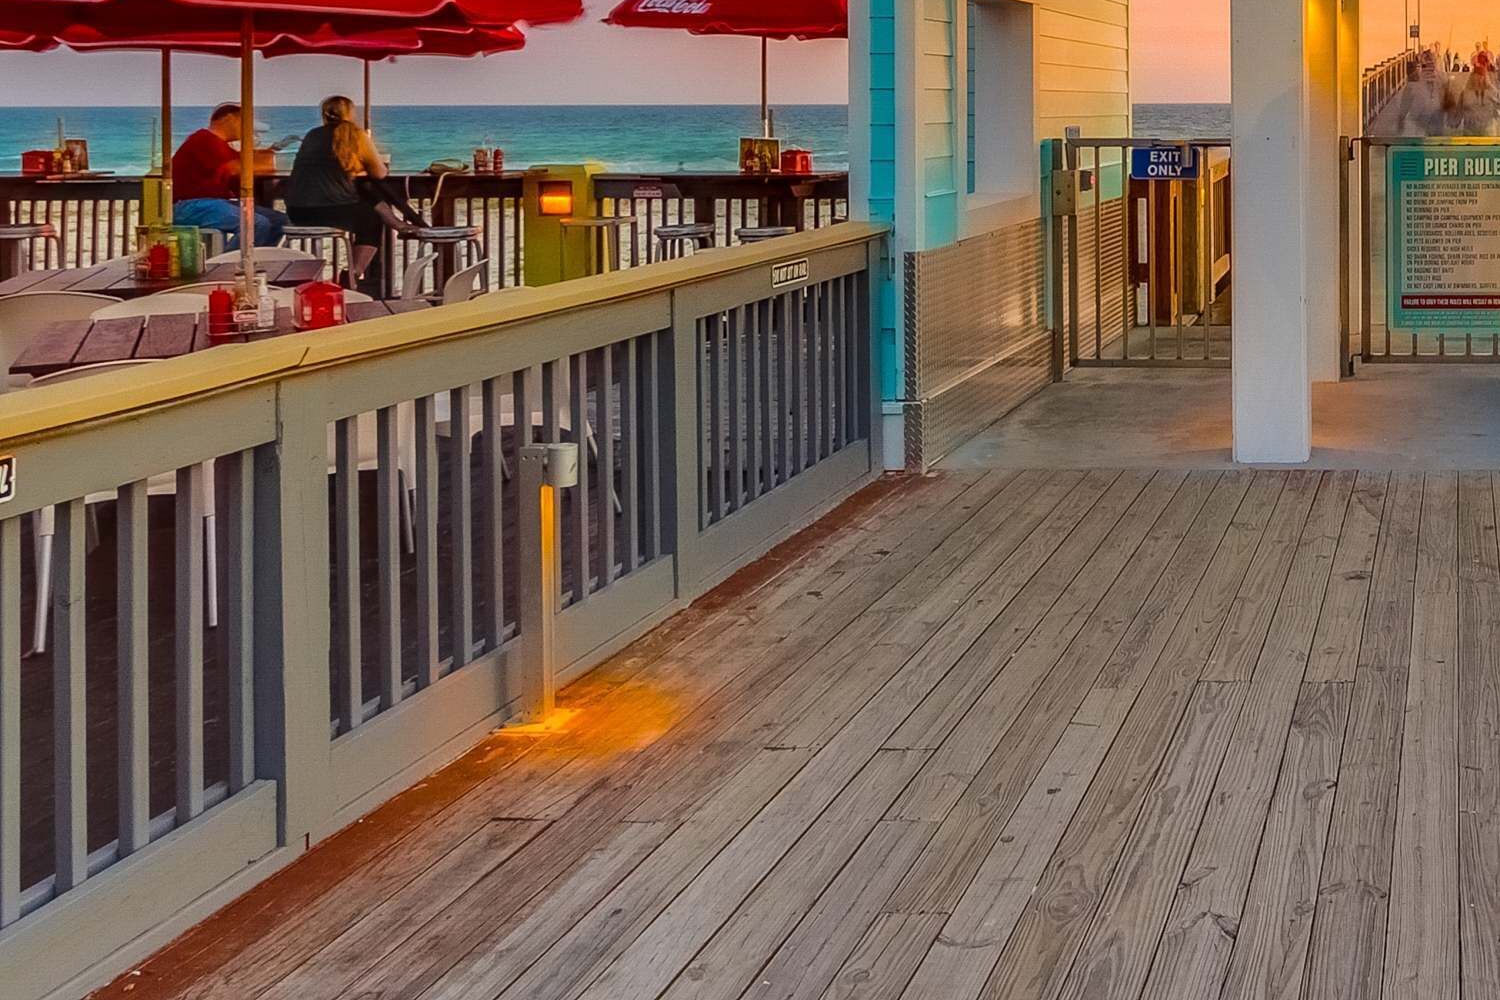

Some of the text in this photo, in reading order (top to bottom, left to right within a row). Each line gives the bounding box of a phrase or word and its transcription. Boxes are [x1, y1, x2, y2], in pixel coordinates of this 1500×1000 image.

[1150, 151, 1181, 163] EXIT
[1147, 165, 1183, 176] ONLY
[1424, 158, 1458, 175] PIER
